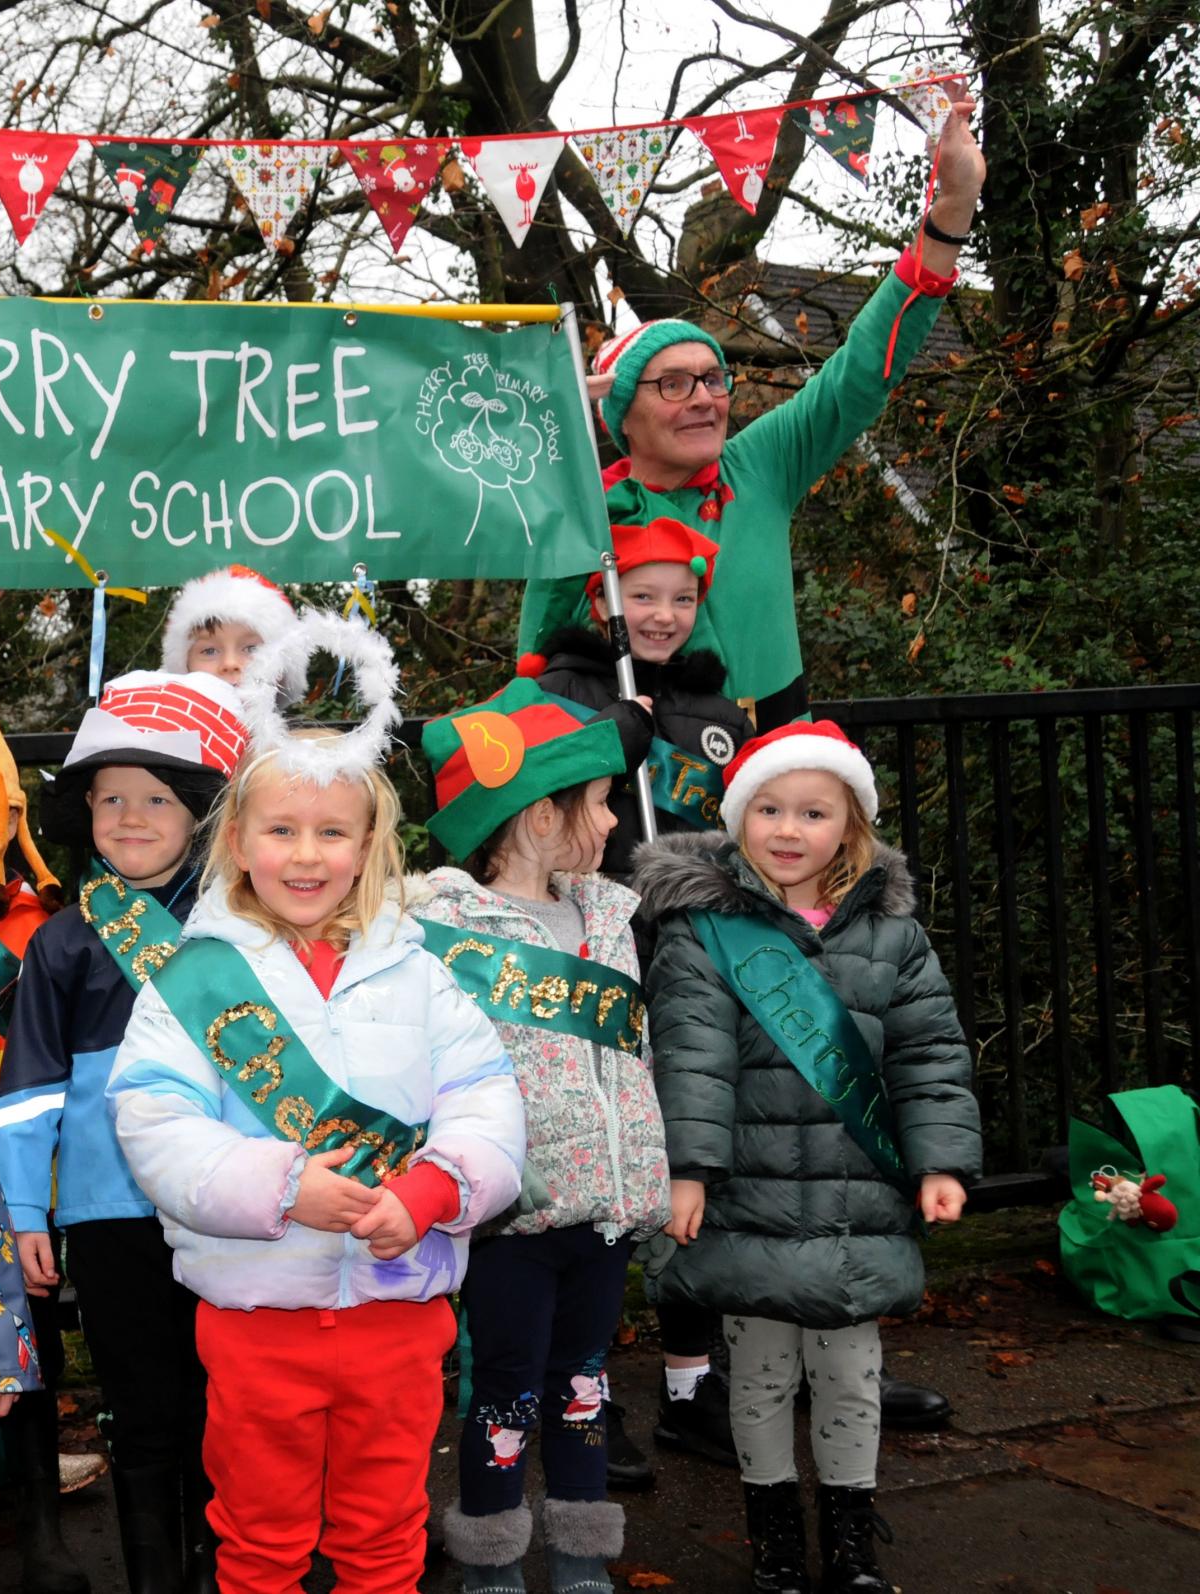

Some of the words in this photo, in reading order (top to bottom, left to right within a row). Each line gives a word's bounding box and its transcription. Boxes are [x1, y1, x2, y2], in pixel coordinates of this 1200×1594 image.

[169, 341, 378, 443] TREE
[415, 361, 453, 435] CHERRY
[463, 352, 489, 366] TREE
[128, 468, 402, 551] SCHOOL
